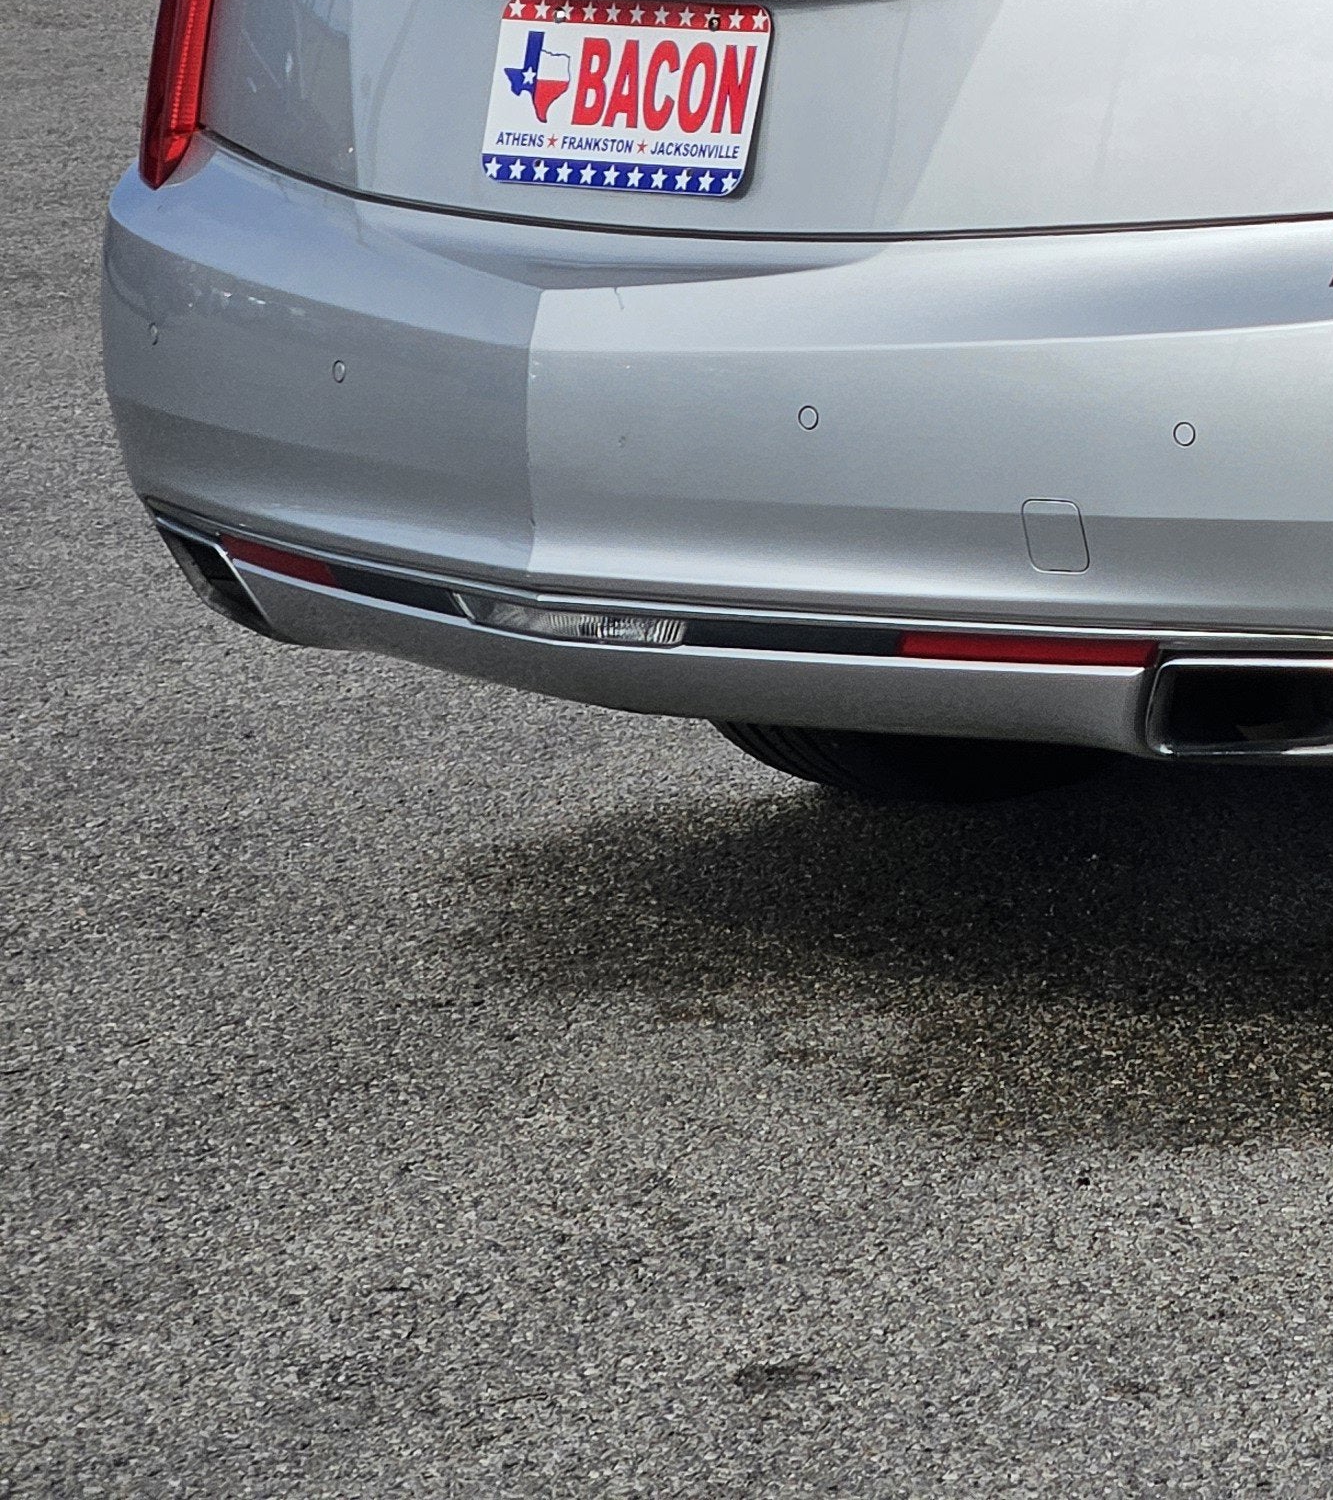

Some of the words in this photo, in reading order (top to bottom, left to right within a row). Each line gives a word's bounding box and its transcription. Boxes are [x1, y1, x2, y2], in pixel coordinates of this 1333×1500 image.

[570, 36, 758, 135] BACON
[495, 131, 545, 148] ATHENS
[560, 138, 635, 154] FRANKSTON
[650, 141, 741, 160] JACKSONVILLE
